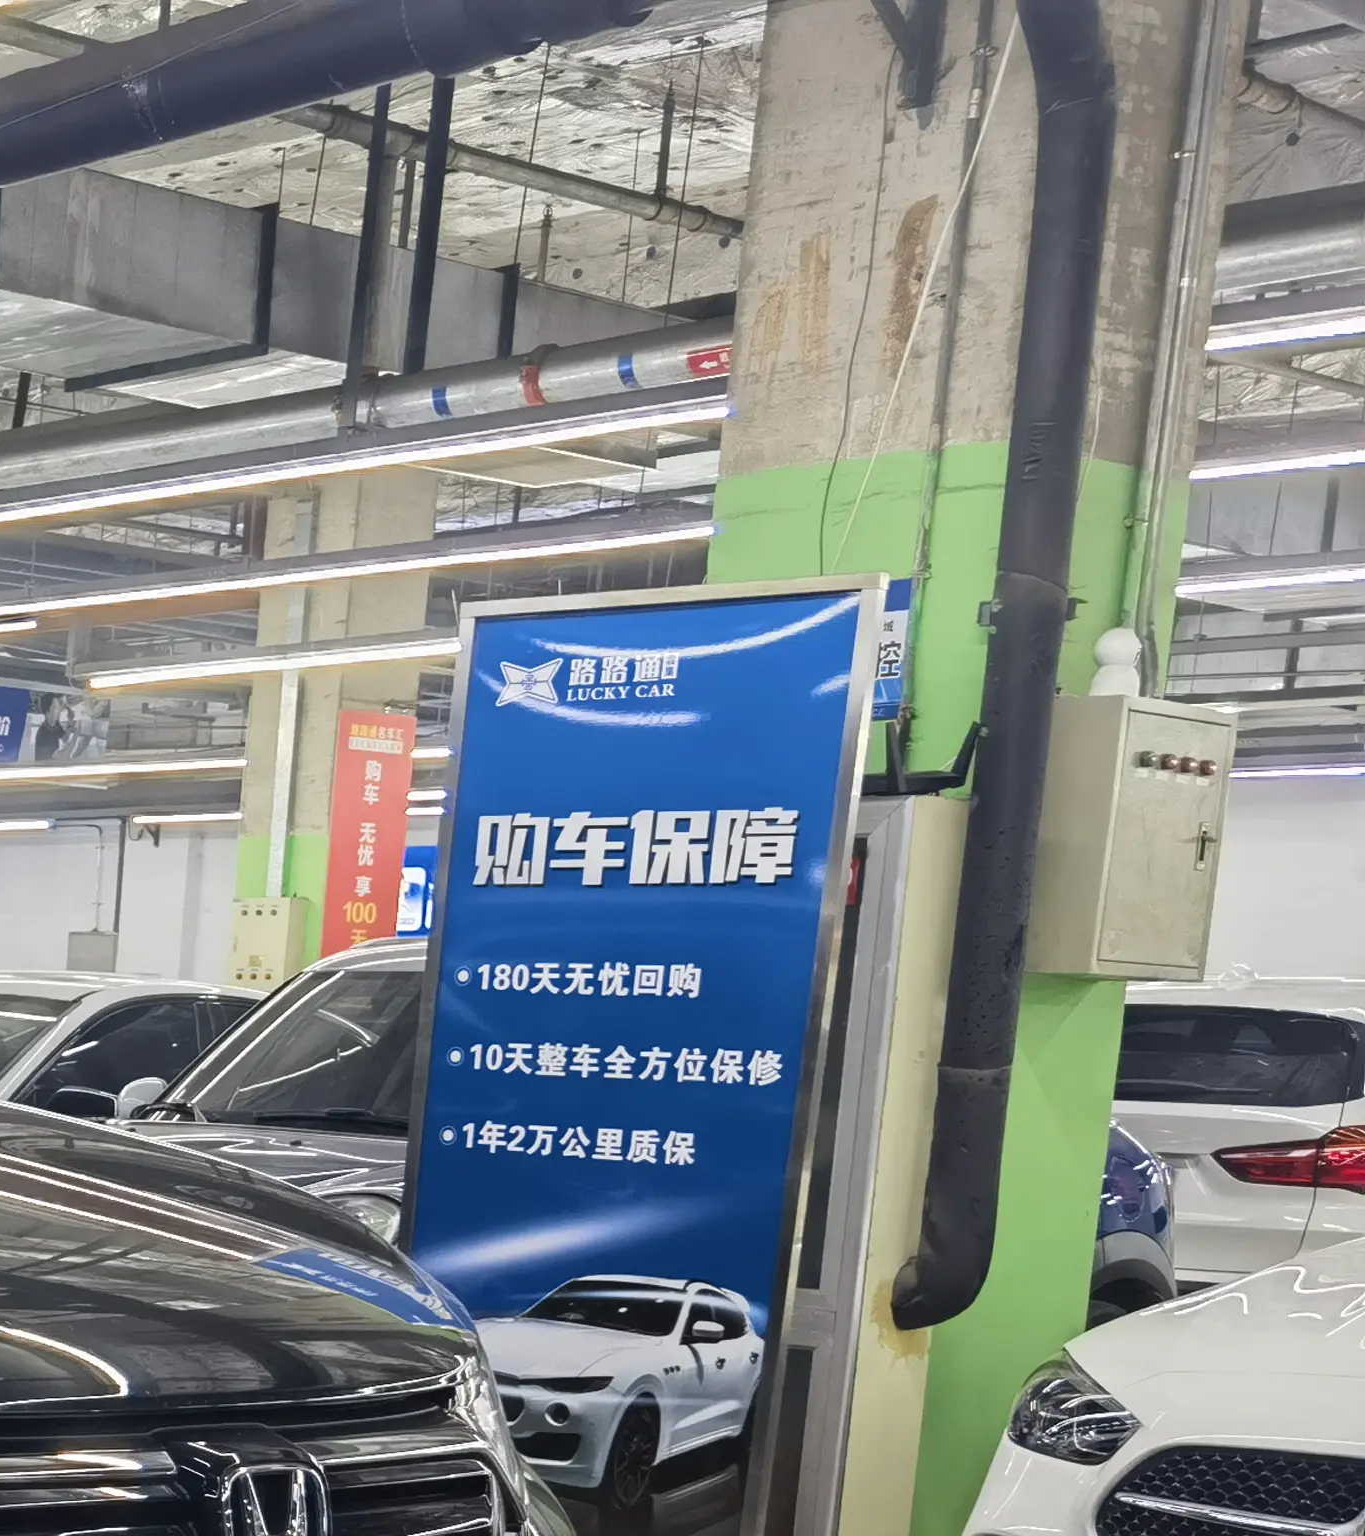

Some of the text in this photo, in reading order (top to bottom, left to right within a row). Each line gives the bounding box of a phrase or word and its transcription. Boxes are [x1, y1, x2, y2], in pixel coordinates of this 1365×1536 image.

[569, 655, 662, 686] 路路通
[566, 684, 676, 702] LUCKY CAR
[472, 806, 800, 887] 购车保障
[342, 902, 377, 924] 100
[476, 963, 702, 999] 180天无忧回购
[469, 1041, 784, 1087] 10天整车全方位保修
[462, 1119, 696, 1166] 1年2万公里质保
